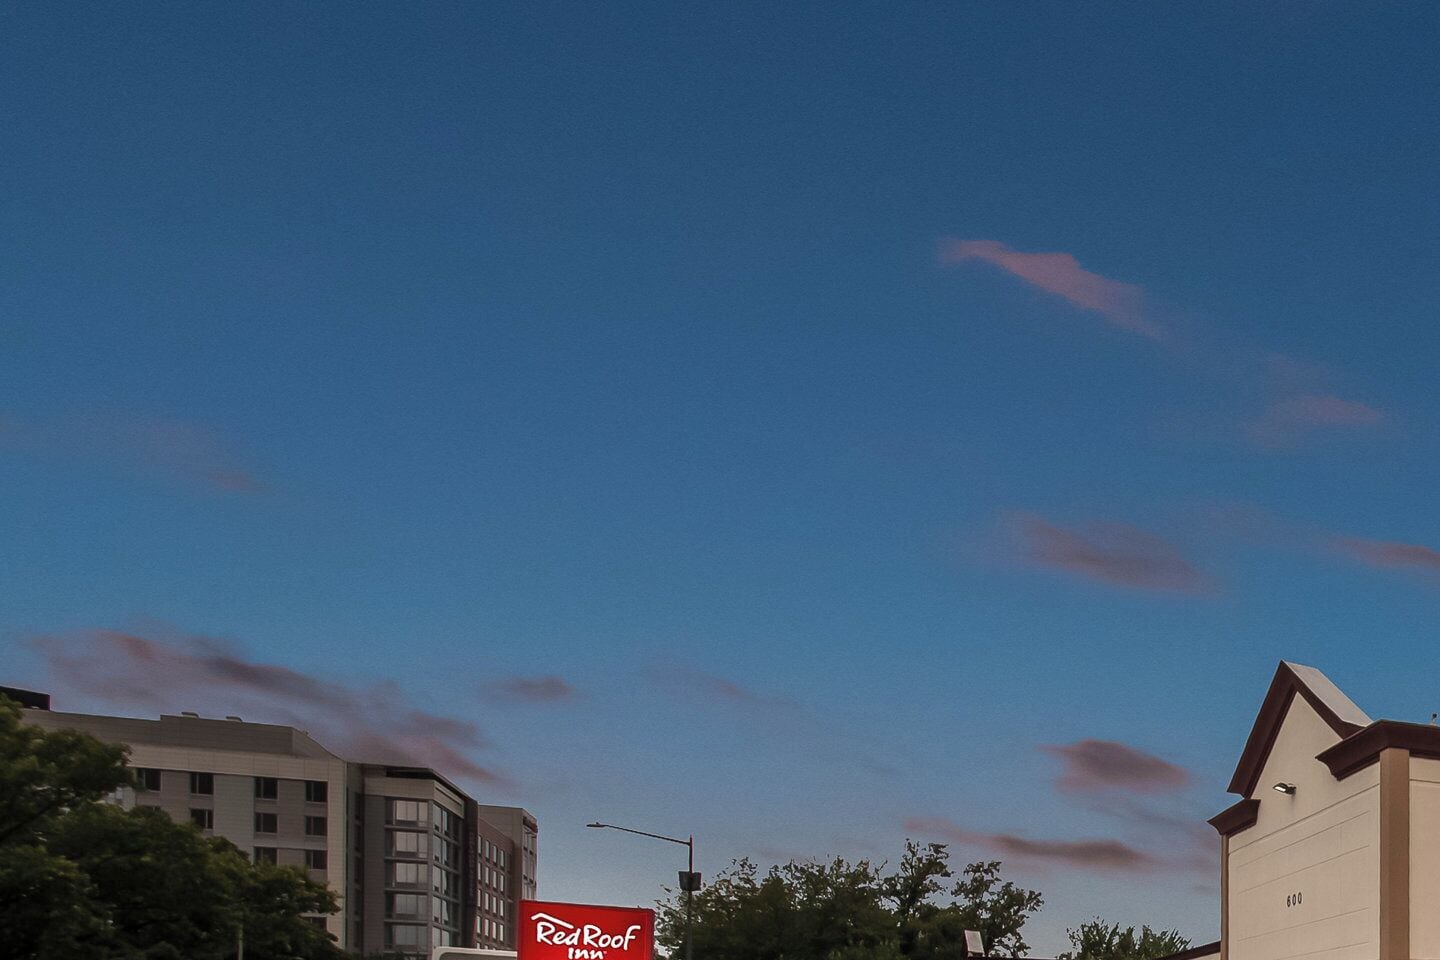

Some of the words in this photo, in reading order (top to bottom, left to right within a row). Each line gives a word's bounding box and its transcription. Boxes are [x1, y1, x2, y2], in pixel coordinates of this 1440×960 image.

[1286, 891, 1303, 908] 600
[536, 921, 581, 945] Red
[583, 924, 641, 951] Roof
